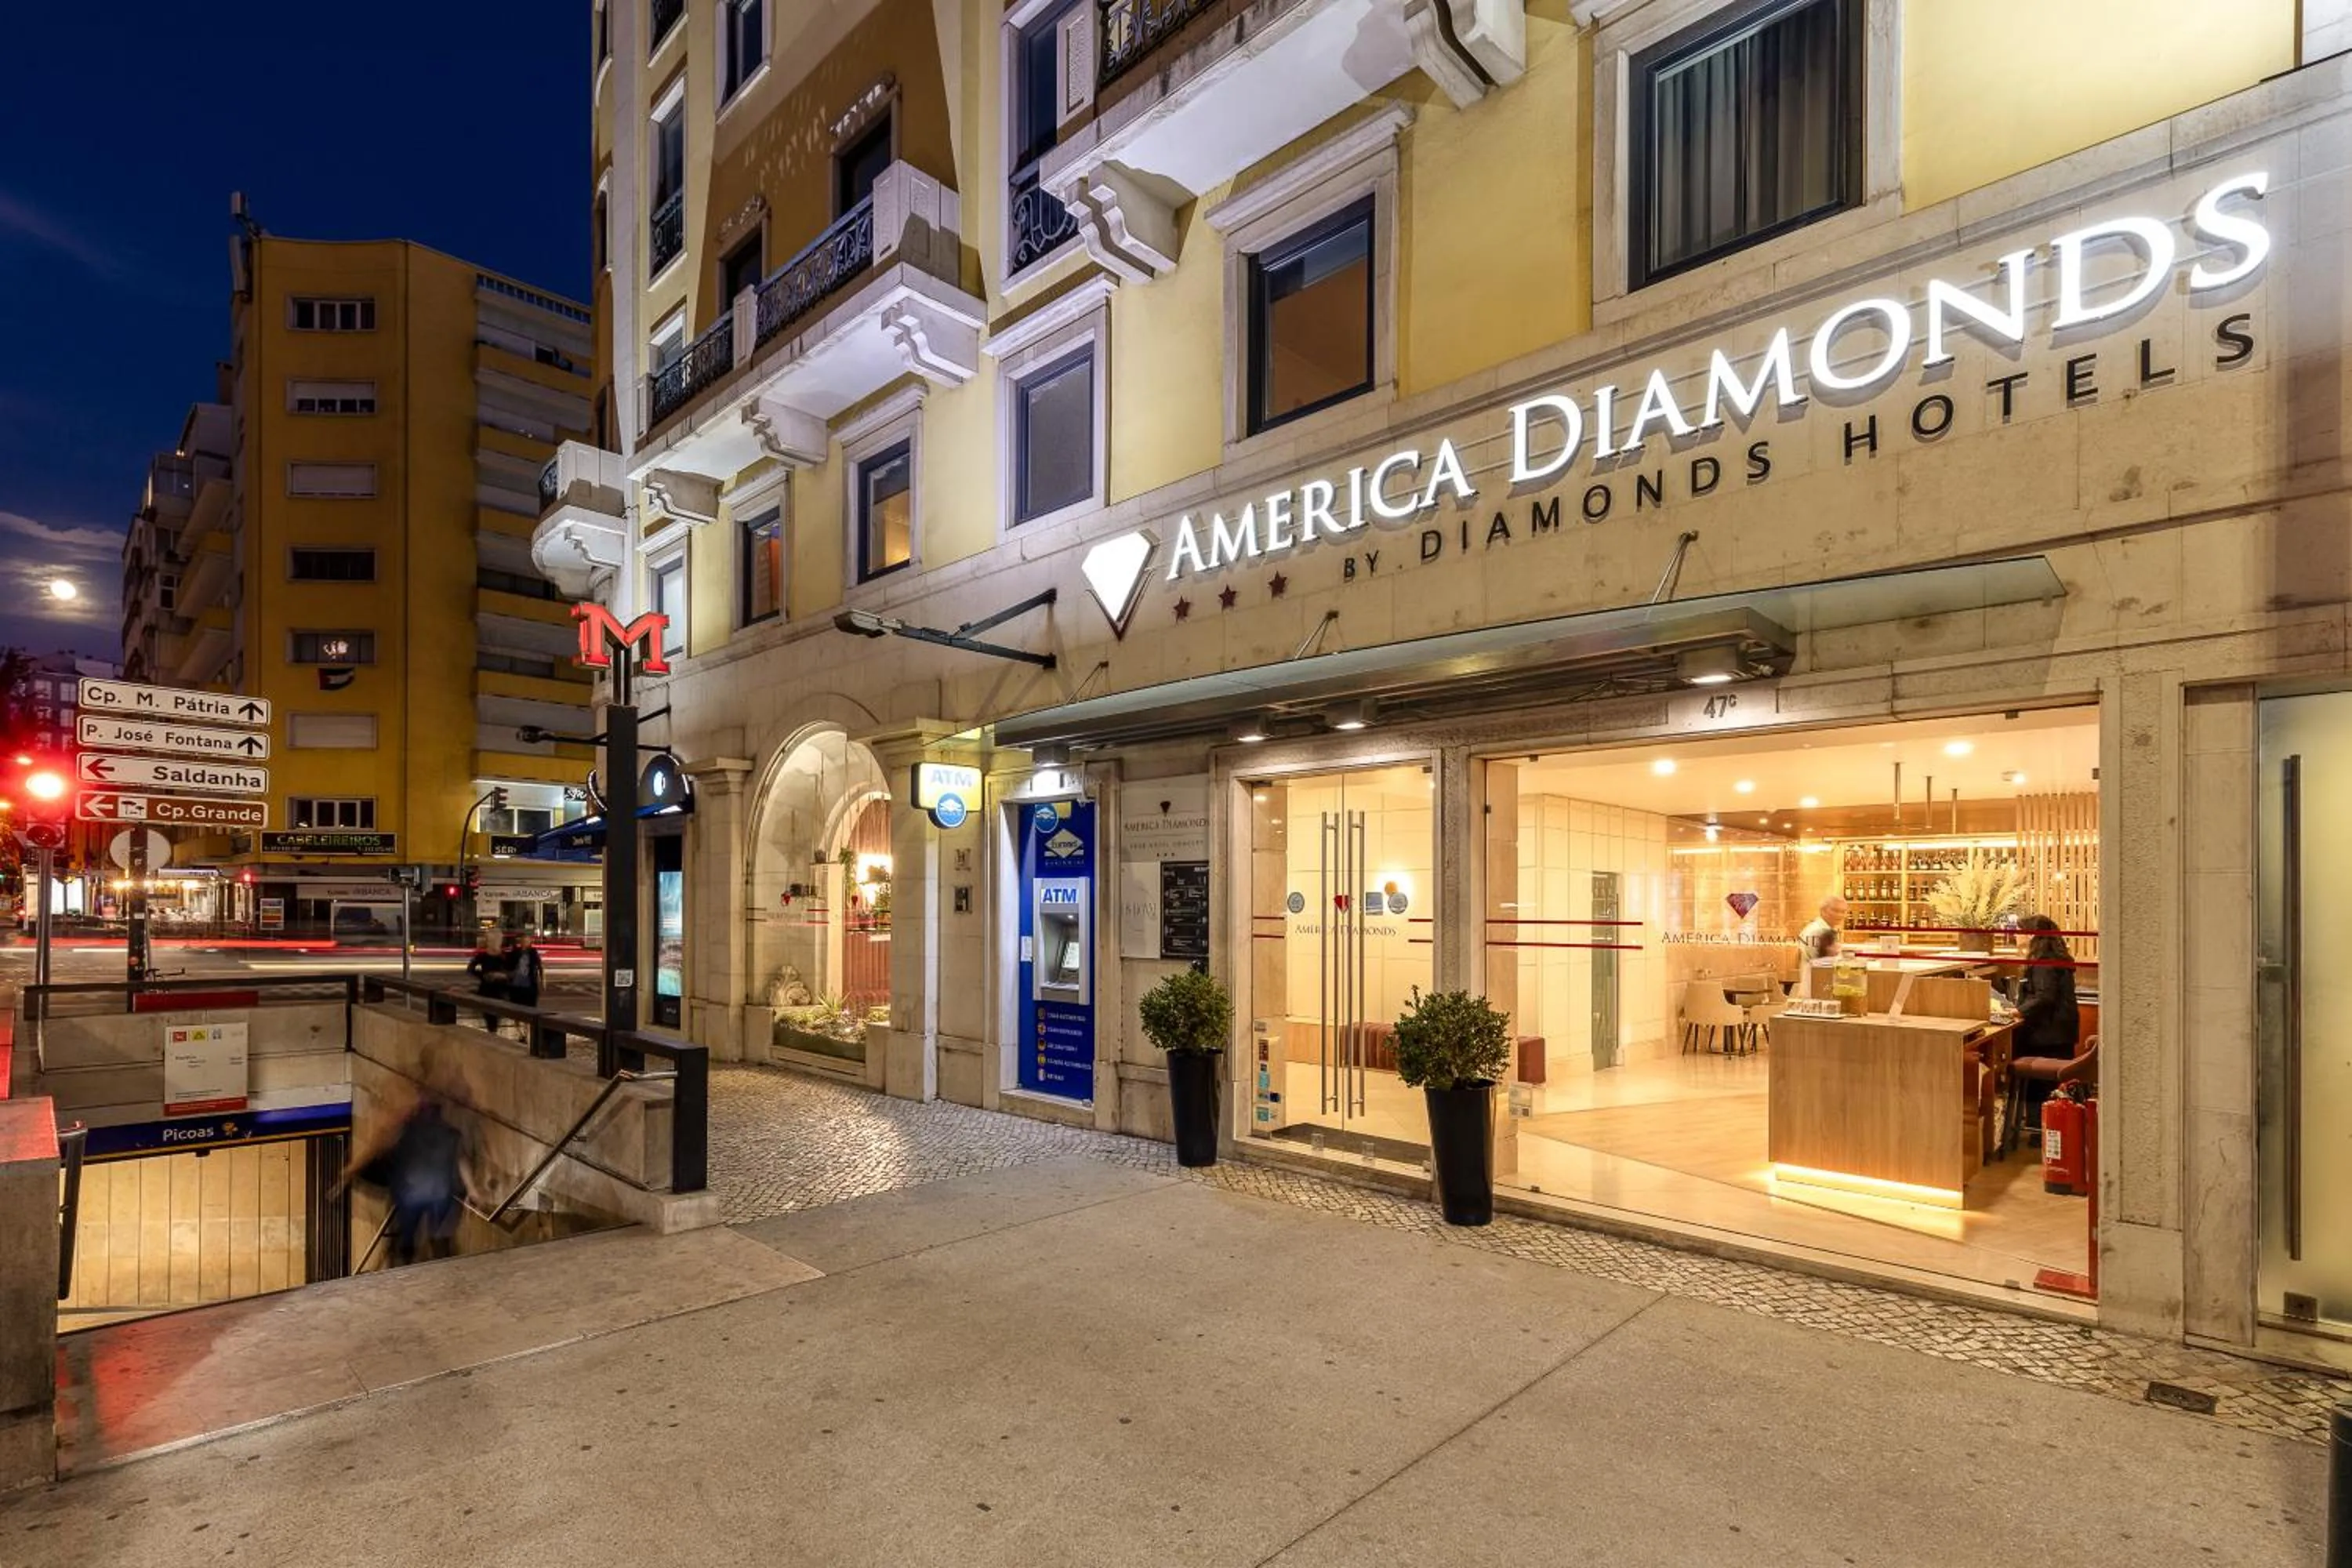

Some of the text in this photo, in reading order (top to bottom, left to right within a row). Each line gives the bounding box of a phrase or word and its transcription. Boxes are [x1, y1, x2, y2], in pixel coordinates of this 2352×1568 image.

[1166, 172, 2270, 580] AMERICA DIAMONDS
[1342, 314, 2253, 579] BY DIAMONDS HOTELS
[571, 602, 670, 676] M
[87, 687, 230, 715] Cp. M. Pátria
[86, 724, 233, 750] P. José Fontana
[152, 766, 261, 788] Saldanha
[930, 769, 972, 788] ATM
[156, 803, 262, 822] Cp.Grande
[1043, 888, 1077, 902] ATM
[1661, 931, 1730, 945] AMERICA
[163, 1127, 214, 1142] Picoas
